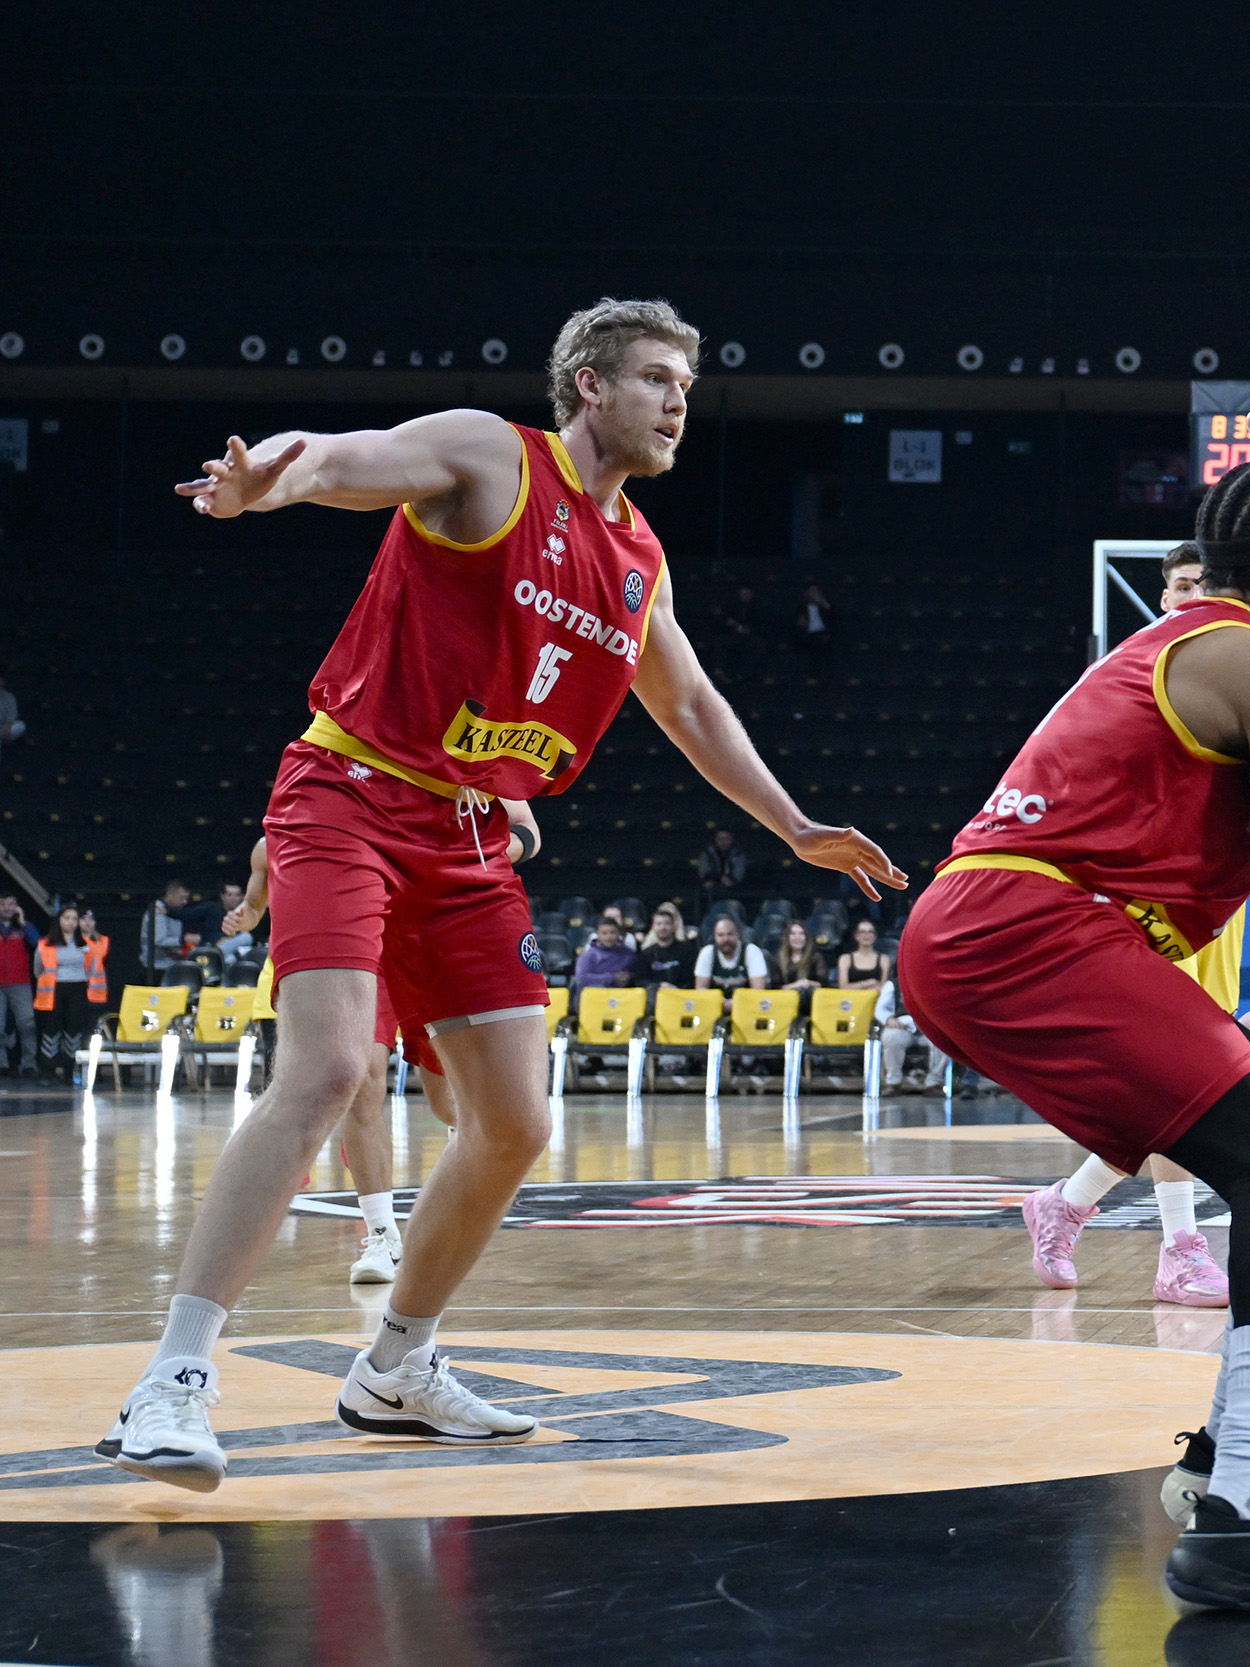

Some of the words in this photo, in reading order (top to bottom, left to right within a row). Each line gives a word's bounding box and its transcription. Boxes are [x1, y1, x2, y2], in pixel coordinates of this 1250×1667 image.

[514, 579, 639, 666] OOSTENDE
[525, 641, 573, 704] 15
[453, 722, 553, 762] KASTEEL
